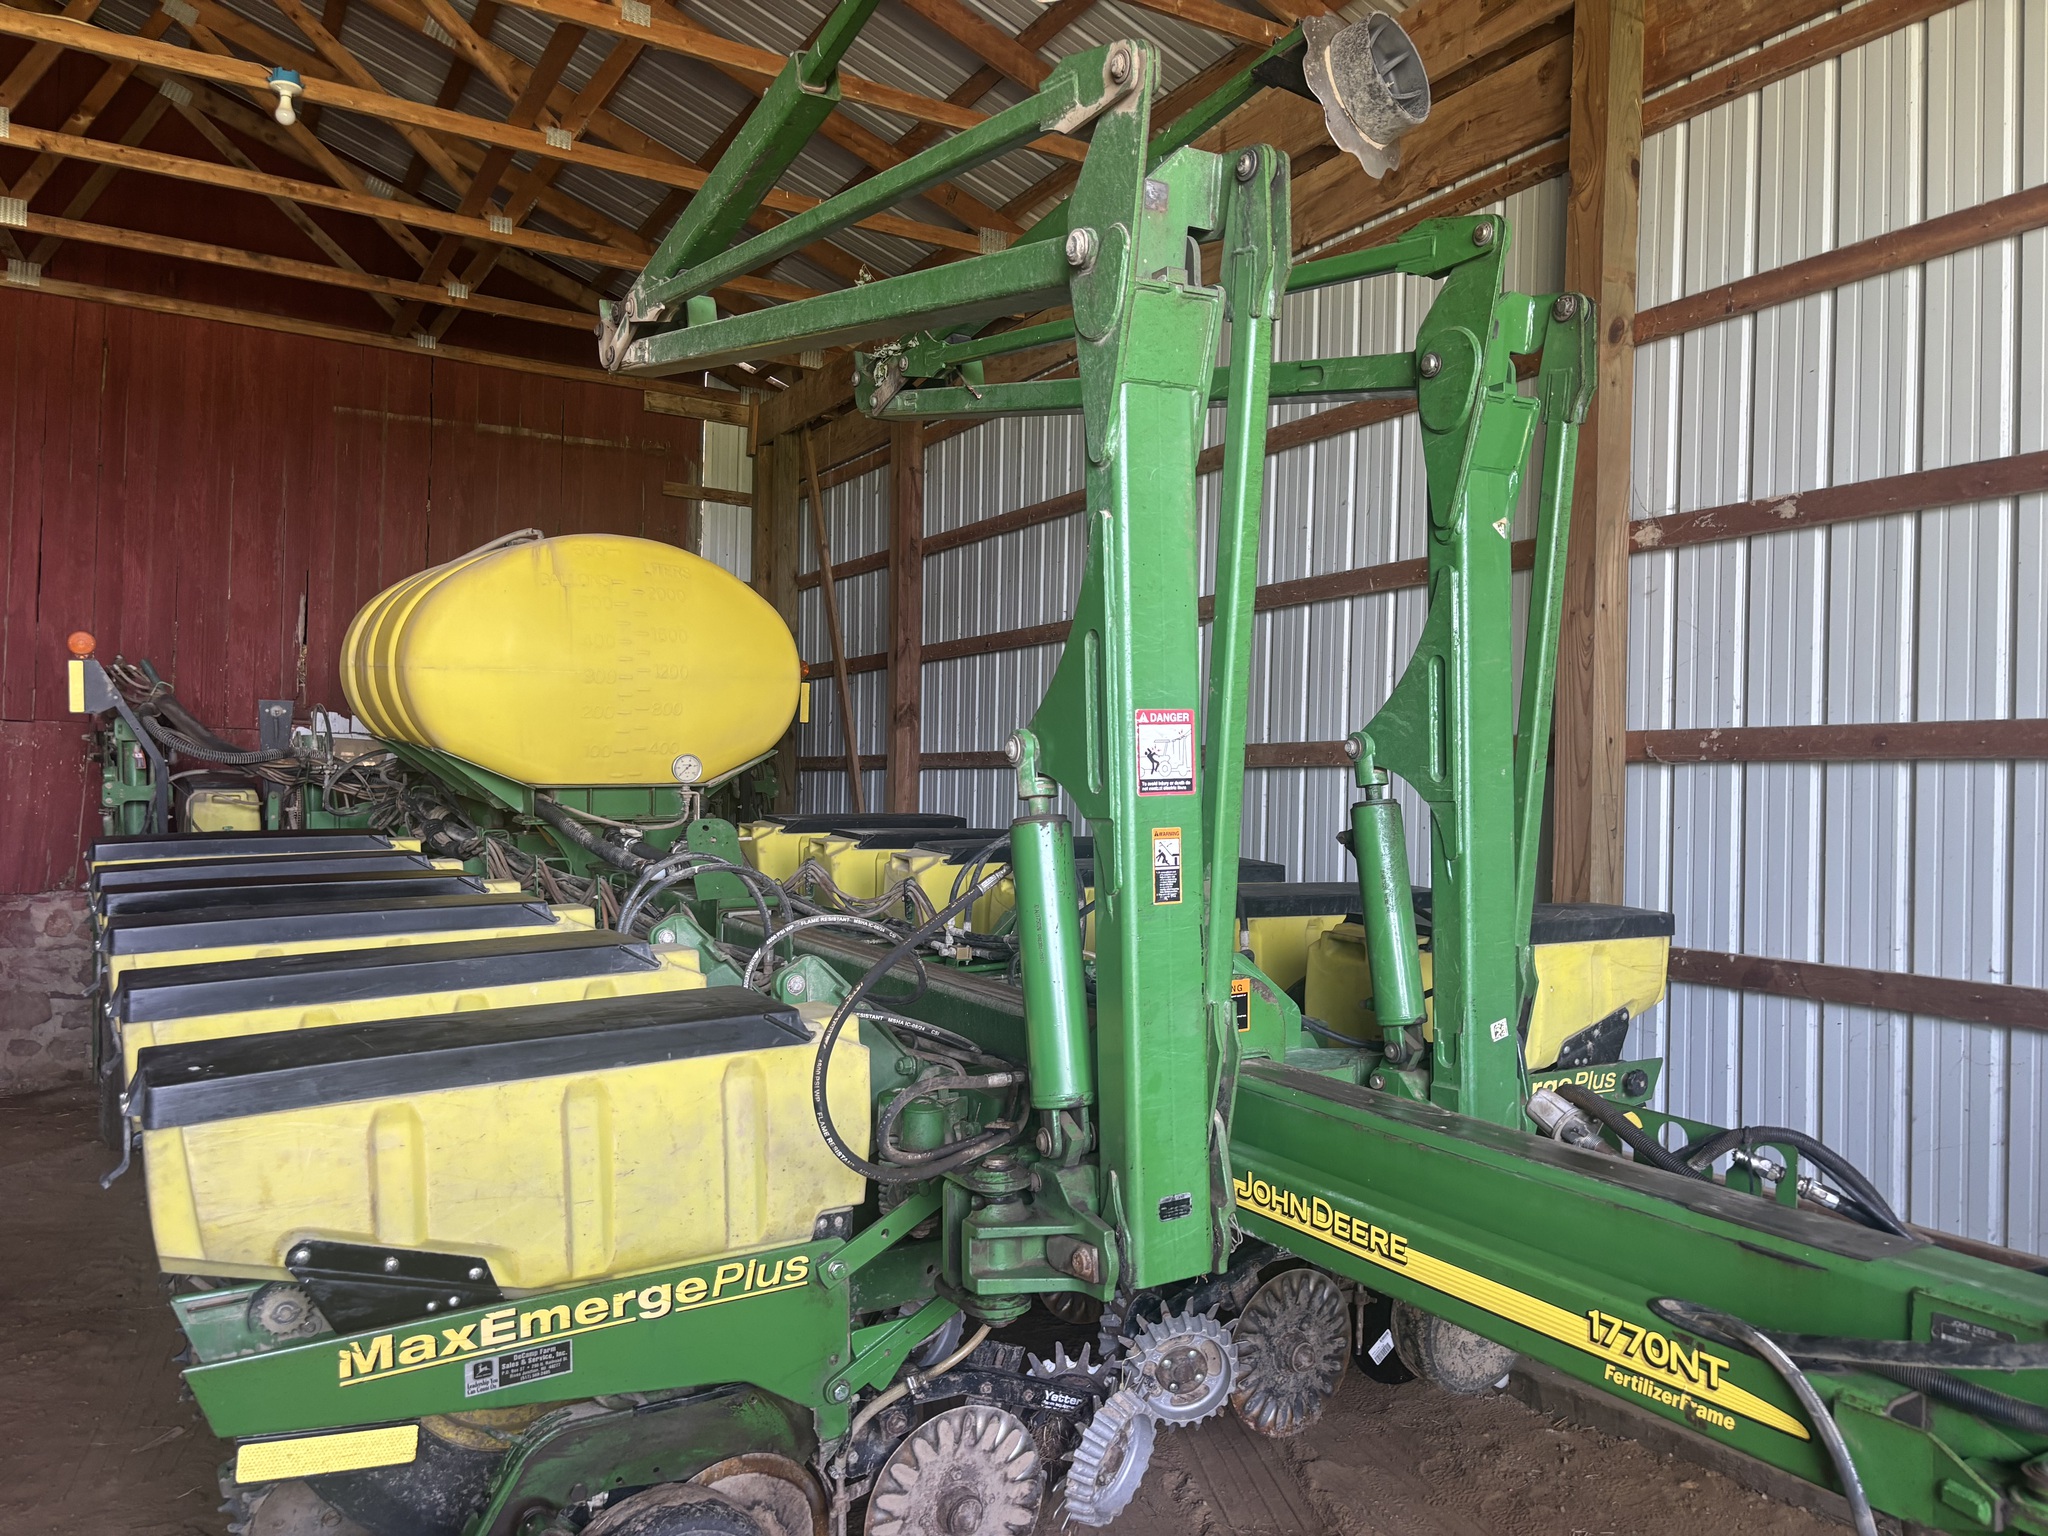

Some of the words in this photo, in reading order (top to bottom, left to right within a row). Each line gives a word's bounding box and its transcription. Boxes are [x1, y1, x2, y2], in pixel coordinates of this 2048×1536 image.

[641, 560, 691, 579] LITERS
[1150, 712, 1189, 722] DANGER
[800, 917, 820, 926] FLAME
[887, 1017, 904, 1026] MSHA
[816, 1112, 830, 1138] FLAME
[1238, 1171, 1308, 1223] JOHN
[1311, 1195, 1408, 1267] DEERE
[1950, 1320, 1970, 1330] JOHN
[1972, 1325, 1998, 1339] DEERE
[539, 1346, 556, 1355] Farm
[1586, 1309, 1730, 1391] 1770NT
[501, 1361, 519, 1370] Sales
[555, 1349, 568, 1358] Inc.
[467, 1379, 490, 1390] Leadership
[1045, 1390, 1083, 1405] Yetter
